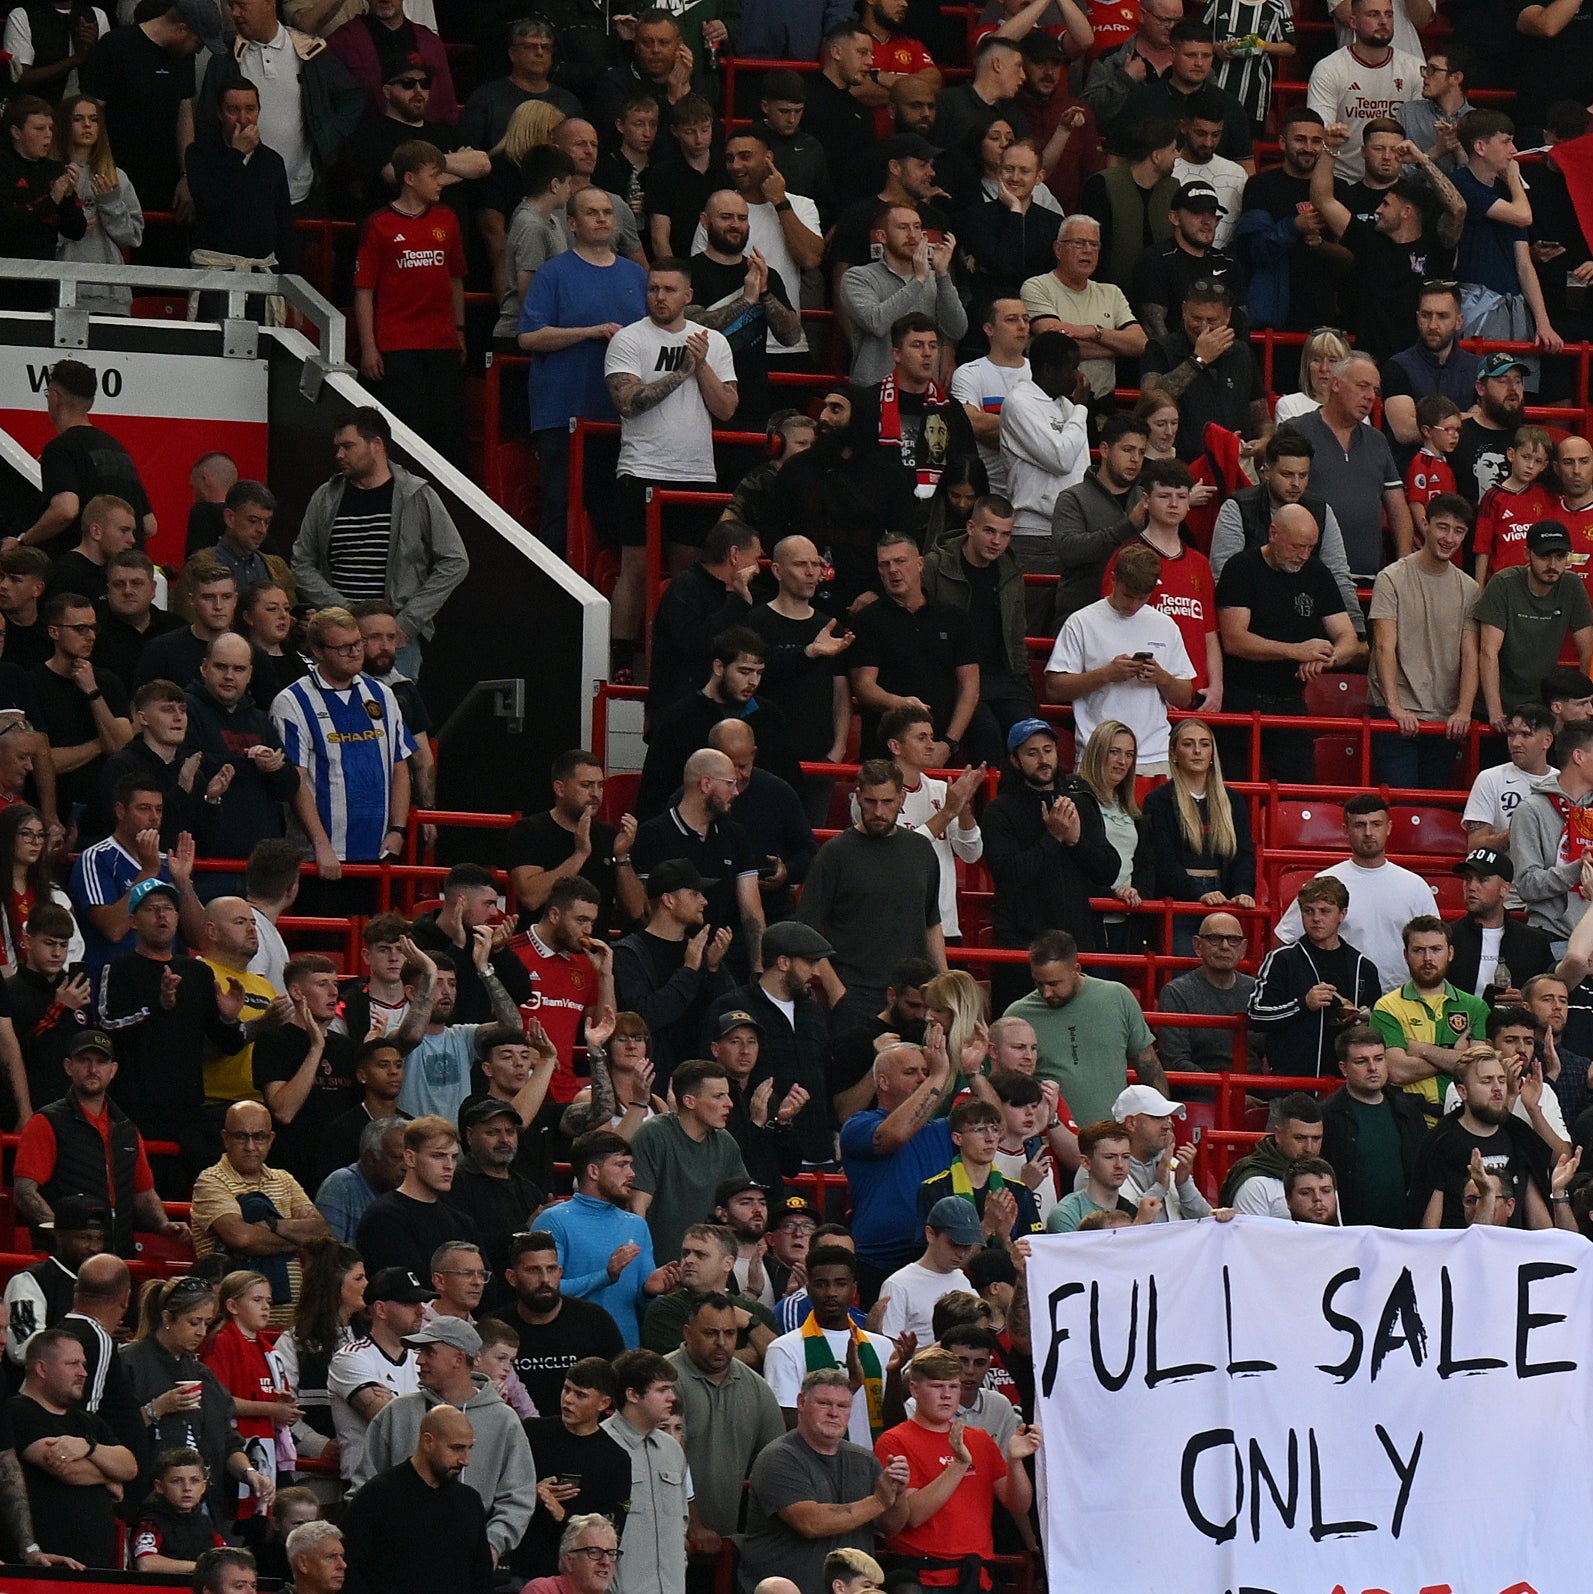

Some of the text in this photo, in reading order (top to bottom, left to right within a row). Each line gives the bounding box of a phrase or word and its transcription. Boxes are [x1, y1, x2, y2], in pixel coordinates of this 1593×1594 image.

[1358, 98, 1388, 111] Team
[1347, 106, 1388, 121] Viewer
[404, 250, 434, 262] Team
[397, 258, 435, 272] Viewer
[1160, 594, 1192, 607] Team
[328, 729, 386, 745] SHARP
[1042, 1262, 1577, 1399] FULL SALE
[1181, 1424, 1423, 1545] ONLY
